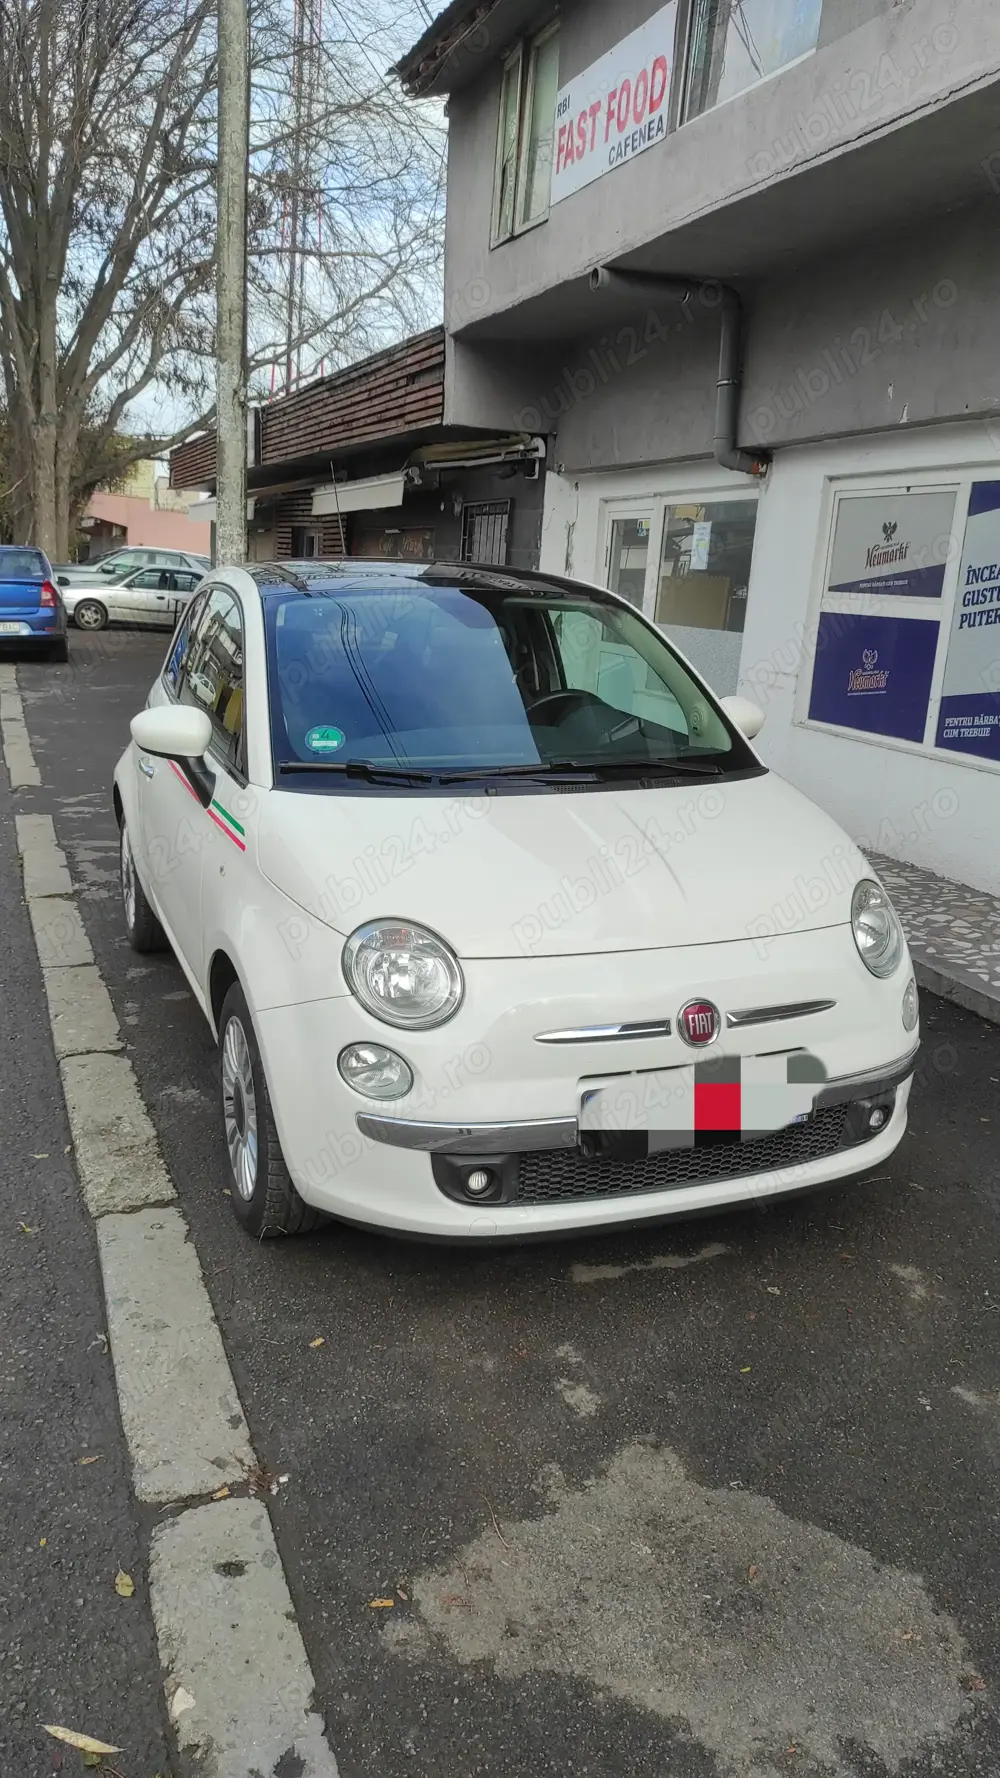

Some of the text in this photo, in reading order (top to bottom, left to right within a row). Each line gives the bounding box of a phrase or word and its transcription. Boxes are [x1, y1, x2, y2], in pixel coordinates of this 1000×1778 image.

[556, 99, 602, 175] FAST
[604, 55, 668, 144] FOOD
[557, 95, 570, 119] RBI
[608, 114, 664, 166] CAFENEA
[865, 541, 911, 570] Neumarkt
[848, 668, 889, 691] Neumarkt
[320, 729, 329, 739] 4
[943, 727, 991, 738] CUM TREBUIE
[944, 717, 972, 727] PENTRU
[688, 1012, 712, 1036] FIAT
